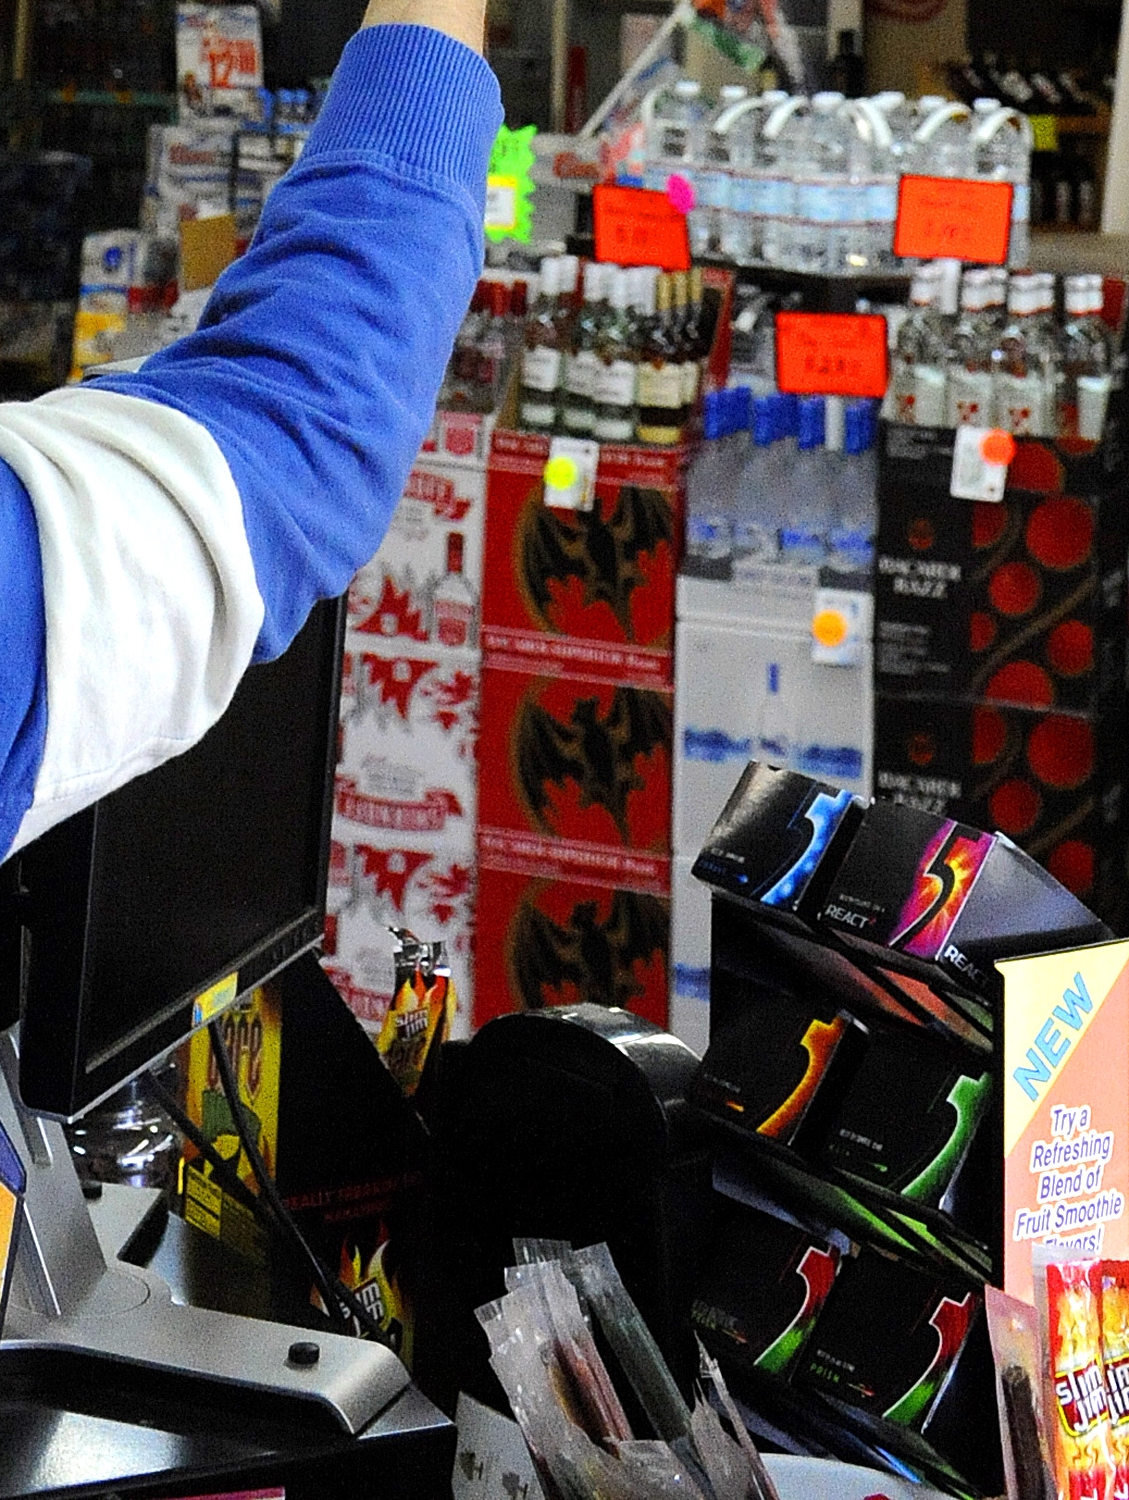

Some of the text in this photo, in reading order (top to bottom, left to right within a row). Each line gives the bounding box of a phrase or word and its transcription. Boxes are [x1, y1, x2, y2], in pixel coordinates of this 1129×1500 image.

[943, 945, 989, 986] REAC
[1013, 971, 1094, 1102] NEW
[1053, 1108, 1089, 1136] Try a
[1033, 1135, 1111, 1169] Refreshing
[1040, 1164, 1101, 1200] Blend of
[1016, 1195, 1122, 1237] Fruit Smoothie
